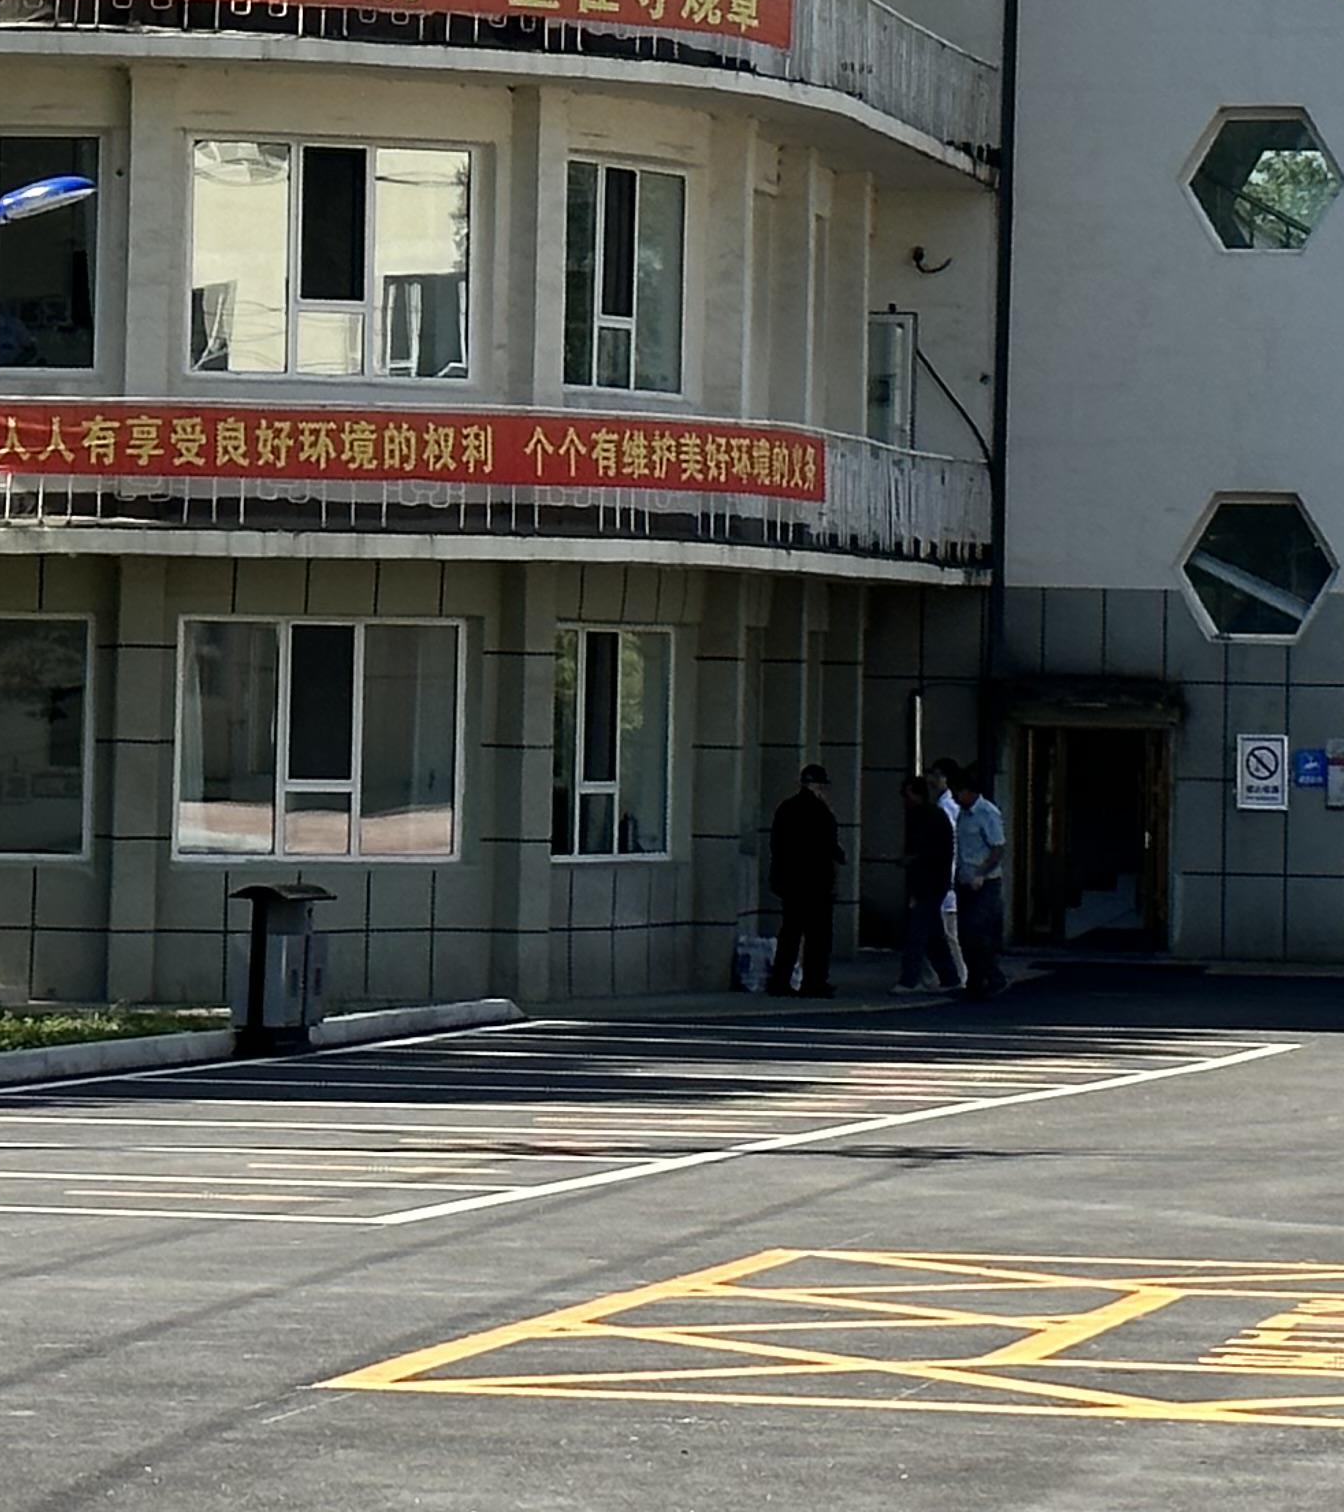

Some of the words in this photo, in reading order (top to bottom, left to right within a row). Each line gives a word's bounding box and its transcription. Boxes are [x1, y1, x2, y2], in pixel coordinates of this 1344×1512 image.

[524, 425, 817, 492] 个个有维护美好环境的义务
